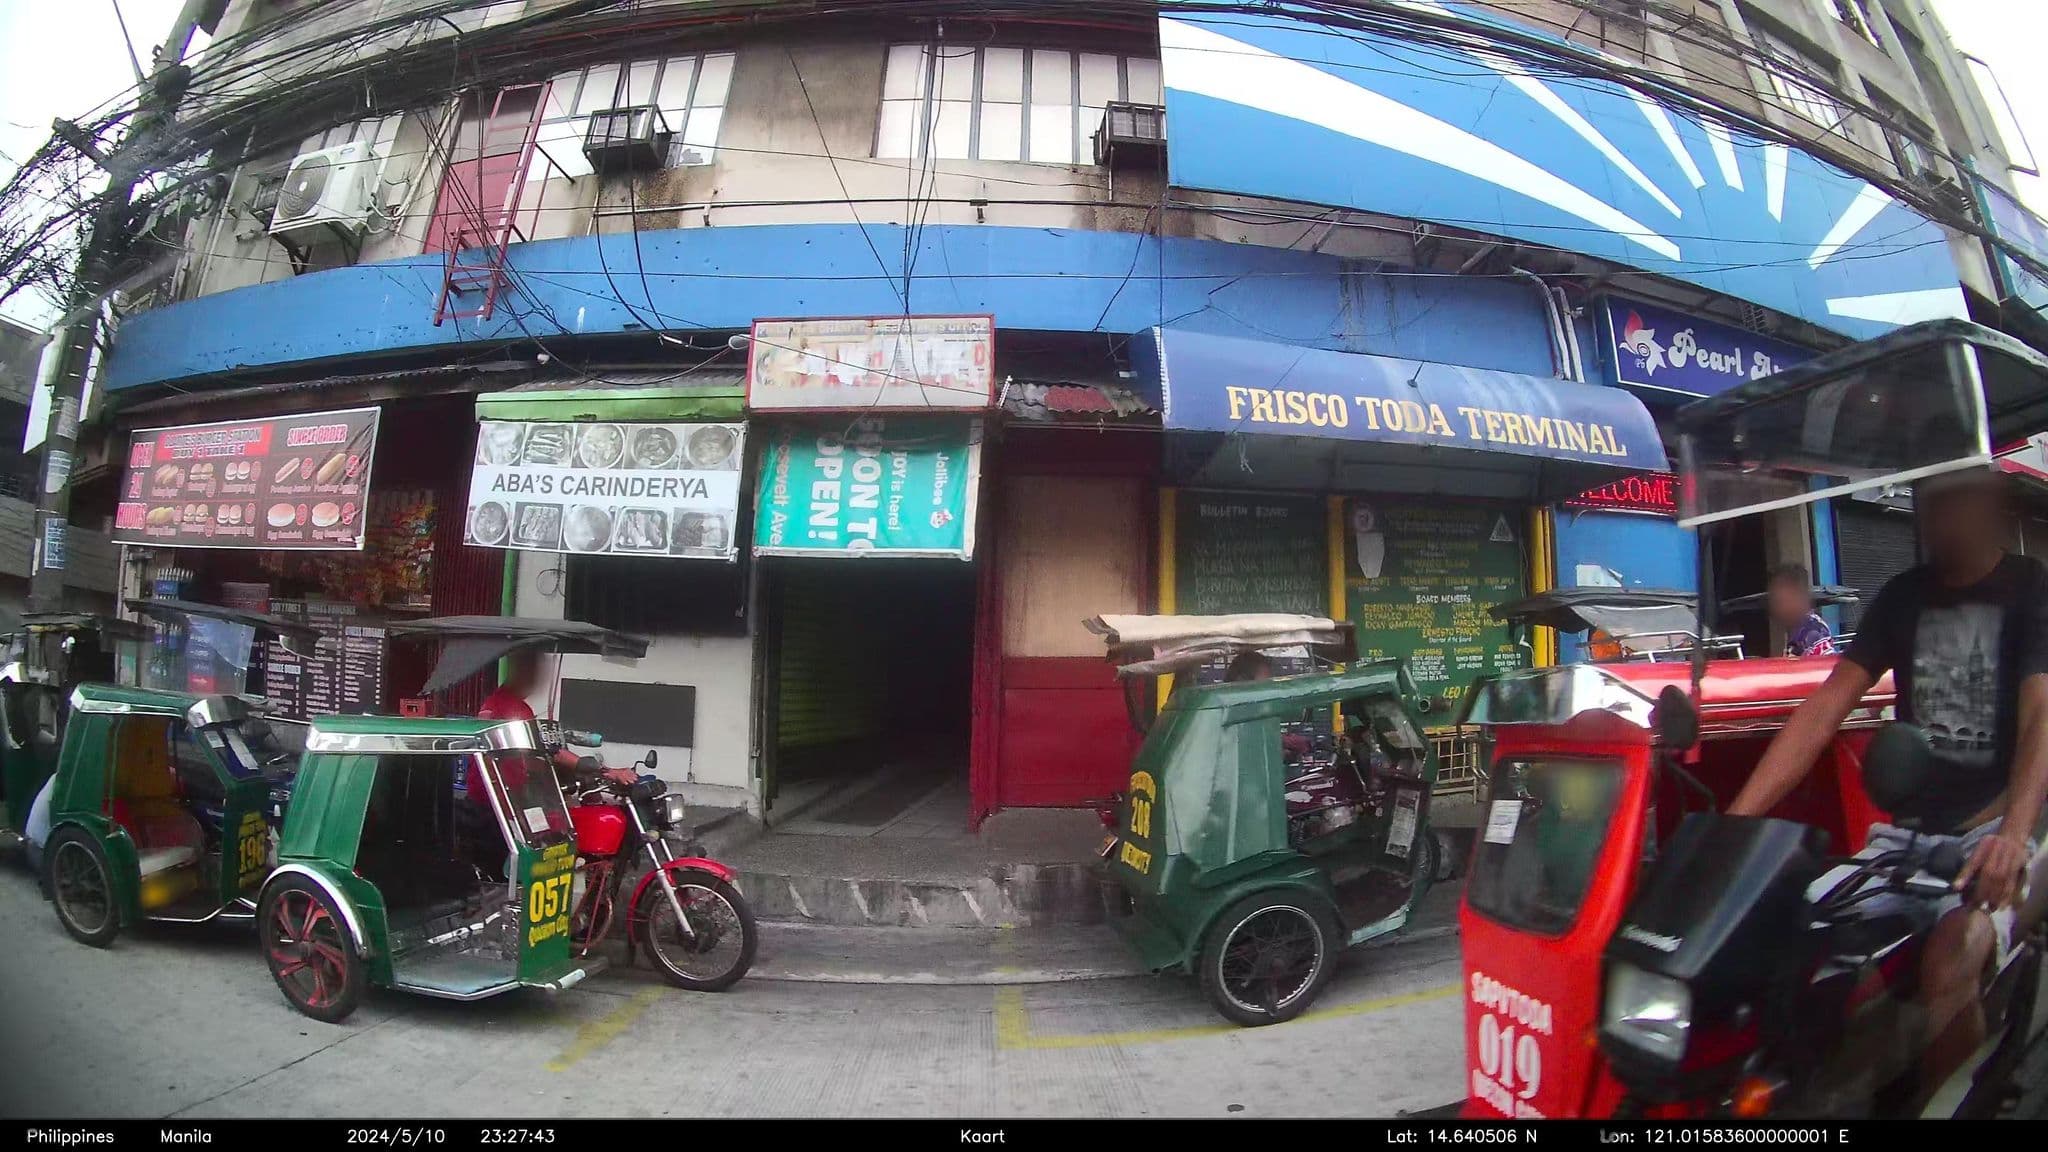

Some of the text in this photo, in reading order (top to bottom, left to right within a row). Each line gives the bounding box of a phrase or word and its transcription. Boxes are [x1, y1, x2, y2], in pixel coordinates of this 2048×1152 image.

[1668, 328, 1784, 381] Pearl A
[1225, 386, 1628, 457] FRISCO TODA TERMINAL
[172, 448, 193, 459] BUY
[206, 445, 235, 457] TAKE
[237, 444, 245, 456] 1
[492, 473, 709, 499] ABA'S CARINDERYA
[808, 433, 844, 541] OPEN!
[891, 480, 904, 492] is
[933, 452, 949, 506] Jollibee
[888, 495, 904, 531] here!
[1200, 504, 1248, 517] BULLETIN
[1441, 594, 1471, 604] MEMBERS
[529, 873, 571, 923] 057
[1478, 1013, 1541, 1099] 019
